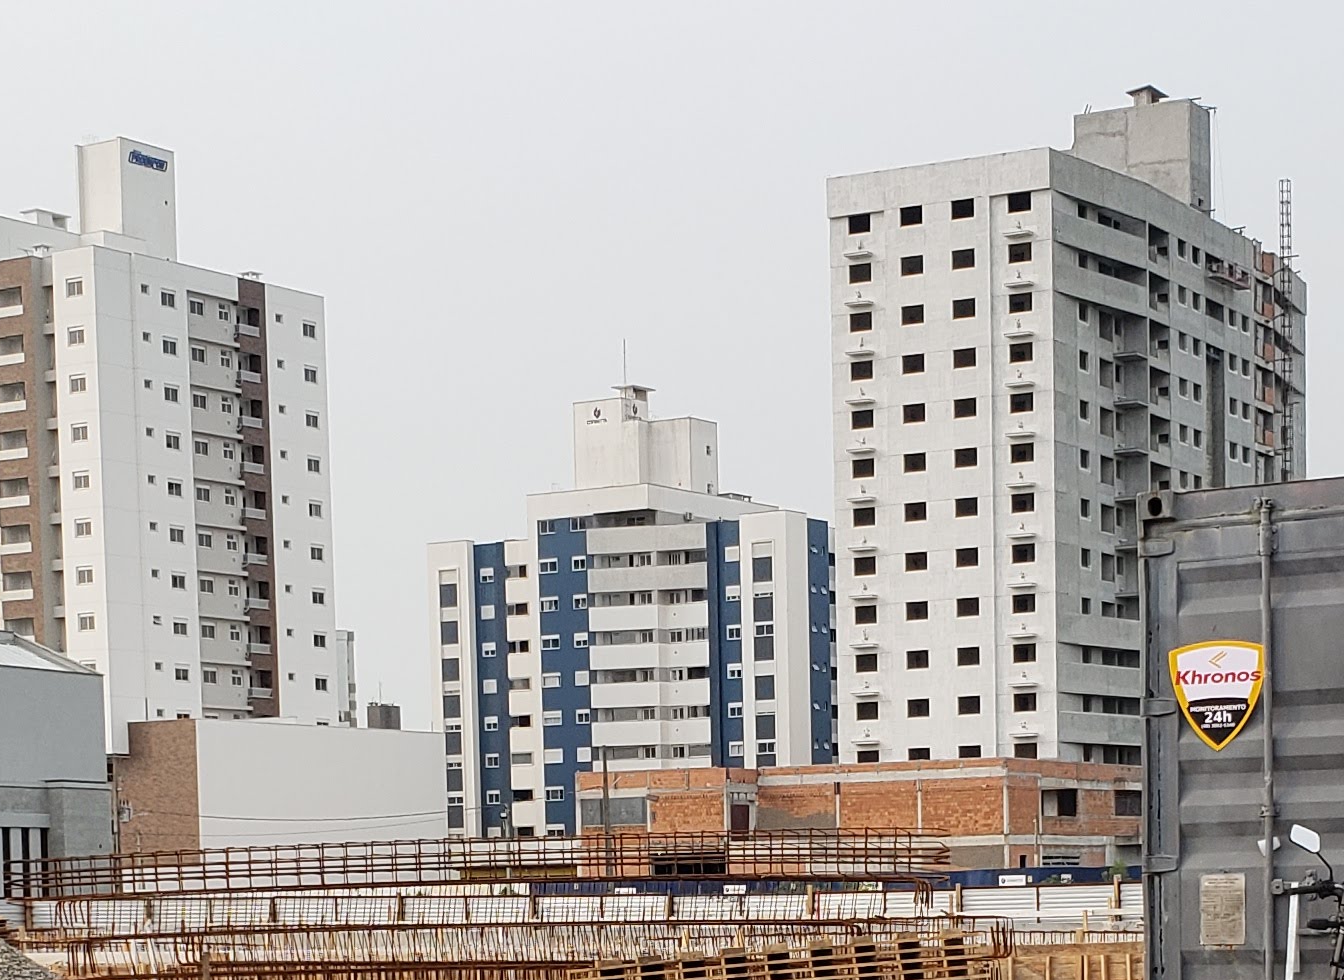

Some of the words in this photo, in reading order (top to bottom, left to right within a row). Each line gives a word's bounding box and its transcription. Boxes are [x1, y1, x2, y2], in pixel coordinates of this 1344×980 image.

[1175, 669, 1262, 686] Khronos
[1189, 703, 1247, 713] MONITORAMENTO
[1204, 710, 1232, 723] 24h
